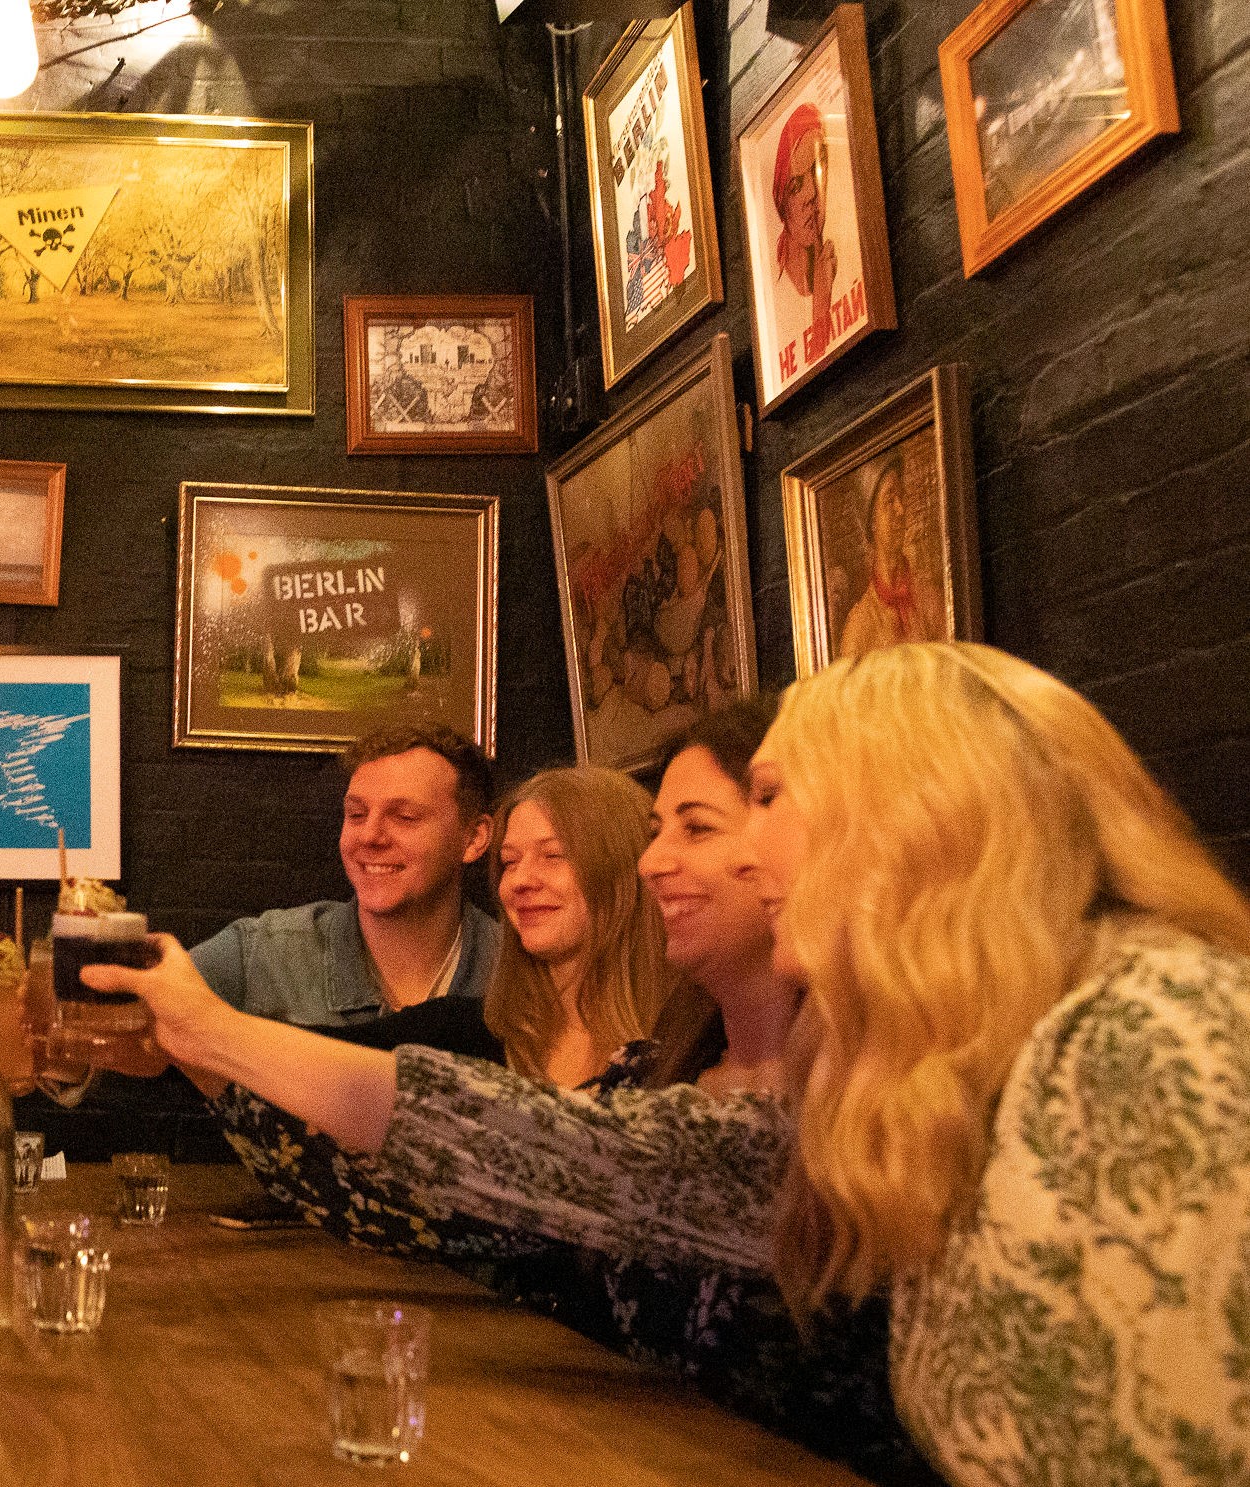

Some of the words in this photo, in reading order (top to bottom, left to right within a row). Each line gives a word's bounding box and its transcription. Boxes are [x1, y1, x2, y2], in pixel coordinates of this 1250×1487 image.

[613, 61, 668, 188] BERLIN
[18, 206, 84, 225] Minen
[779, 339, 798, 384] НЕ
[802, 278, 865, 365] БЛТАЙ
[273, 567, 385, 600] BERLIN
[300, 603, 367, 634] BAR
